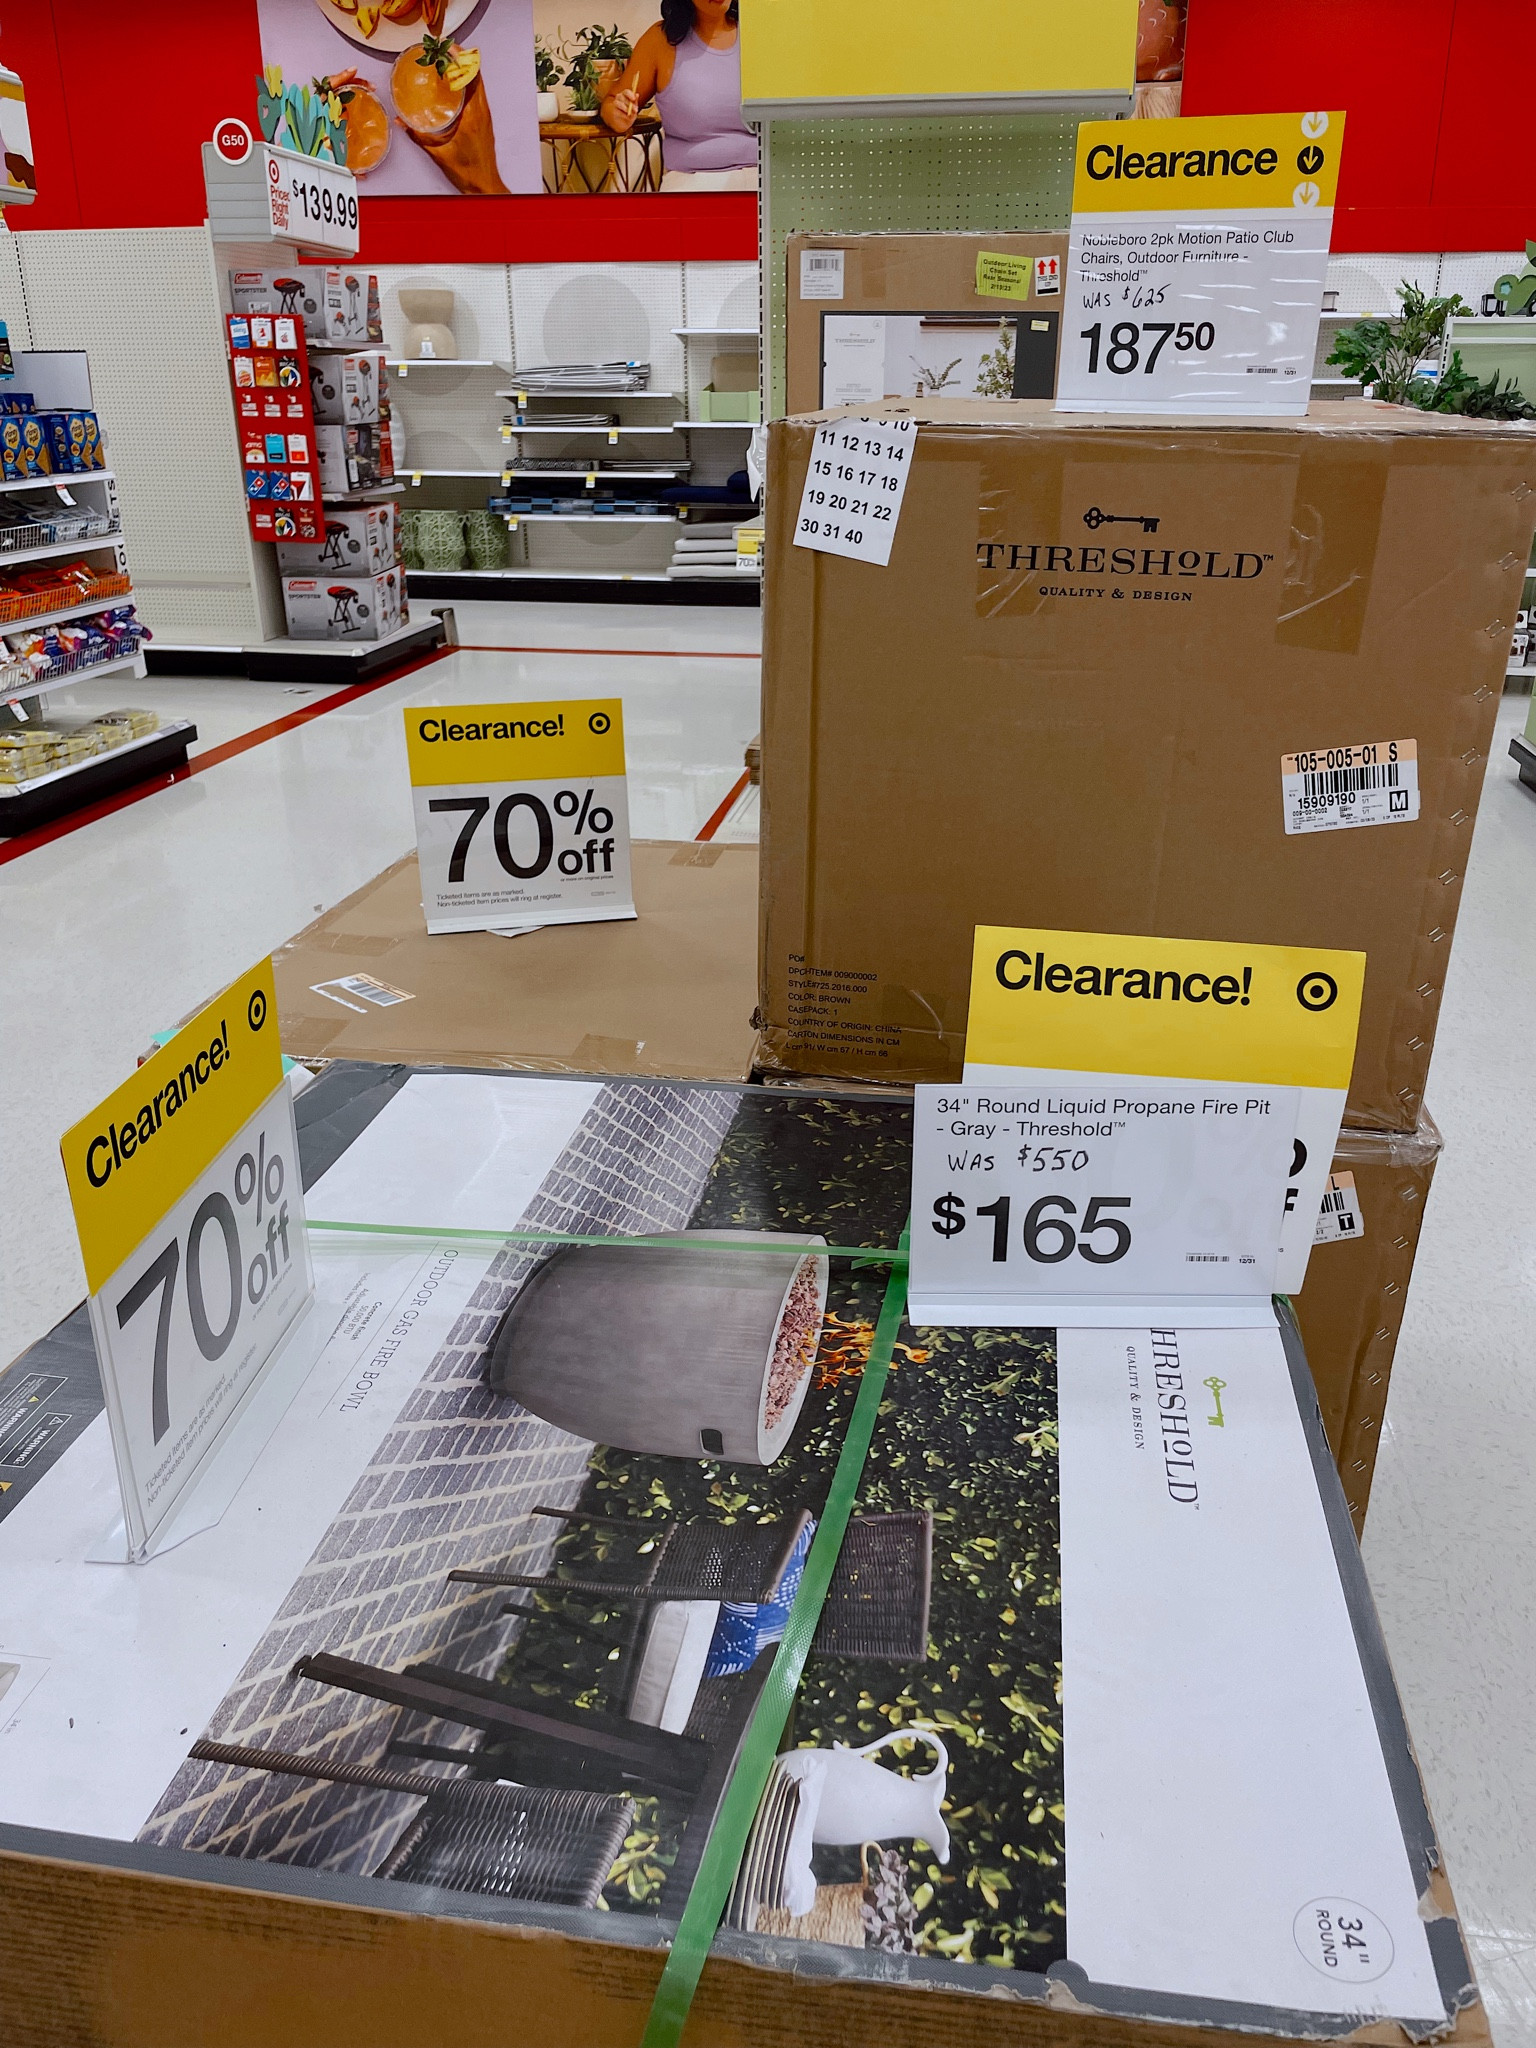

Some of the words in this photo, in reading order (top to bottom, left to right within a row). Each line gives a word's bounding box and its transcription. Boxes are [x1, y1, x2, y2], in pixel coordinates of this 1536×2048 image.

[222, 134, 245, 147] G50
[1086, 144, 1278, 181] Clearance
[293, 179, 358, 230] $139.99
[1082, 234, 1147, 247] Nobleboro
[1150, 233, 1173, 247] 2pk
[1178, 232, 1222, 245] Motion
[1226, 231, 1259, 244] Patio
[1263, 230, 1294, 243] Club
[1080, 252, 1123, 265] Chairs,
[1127, 251, 1179, 263] Outdoor
[1182, 250, 1239, 262] Furniture
[1083, 292, 1111, 309] WAS
[1121, 283, 1172, 309] $625
[820, 430, 836, 446] 11
[842, 435, 860, 451] 12
[864, 440, 882, 456] 13
[886, 446, 904, 462] 14
[814, 460, 832, 476] 15
[836, 465, 854, 481] 16
[858, 470, 876, 486] 17
[880, 475, 898, 492] 18
[808, 489, 825, 505] 19
[828, 494, 847, 510] 20
[850, 499, 868, 515] 21
[872, 505, 892, 521] 22
[800, 518, 819, 534] 30
[822, 523, 840, 539] 31
[844, 529, 863, 544] 40
[1039, 586, 1105, 598] QUALITY
[1111, 588, 1124, 599] &
[1133, 590, 1192, 601] DESIGN
[419, 714, 565, 743] Clearance!
[1294, 744, 1377, 773] 105-005-01
[1388, 742, 1398, 763] S
[1292, 807, 1327, 816] 009-00-0002
[1298, 792, 1356, 809] 15909190
[1391, 792, 1406, 810] M
[557, 838, 614, 876] off
[437, 892, 463, 900] Ticketed
[437, 899, 475, 908] Non-ticketed
[520, 894, 532, 902] ring
[788, 953, 805, 962] PO#
[834, 970, 878, 981] 009000002
[995, 948, 1253, 1007] Clearance!
[818, 994, 851, 1004] BROWN
[787, 1017, 826, 1027] COUNTRY
[826, 1020, 839, 1028] OF
[875, 1024, 902, 1034] CHINA
[787, 1030, 819, 1039] CARTON
[820, 1032, 874, 1044] DIMENSIONS
[875, 1037, 884, 1045] IN
[886, 1038, 900, 1046] CM
[85, 1018, 231, 1188] Clearance!
[937, 1098, 969, 1114] 34"
[976, 1098, 1040, 1114] Round
[1047, 1098, 1106, 1117] Liquid
[1113, 1099, 1195, 1118] Propane
[1202, 1099, 1239, 1114] Fire
[1245, 1099, 1271, 1115] Pit
[950, 1121, 996, 1140] Gray
[948, 1150, 995, 1172] WAS
[1017, 1143, 1090, 1173] $550
[1331, 1176, 1340, 1191] L
[931, 1191, 1132, 1264] $165
[1340, 1214, 1351, 1228] T
[247, 1199, 291, 1305] off
[412, 1249, 459, 1307] OUTDOOR
[361, 1301, 382, 1327] Concrete
[391, 1310, 420, 1337] GAS
[369, 1339, 402, 1368] FIRE
[1126, 1346, 1139, 1389] QUALITY
[339, 1371, 380, 1413] BOWL
[1130, 1393, 1142, 1401] &
[1131, 1407, 1145, 1450] DESIGN
[1316, 1909, 1338, 1968] ROUND
[1338, 1916, 1370, 1964] 34"
